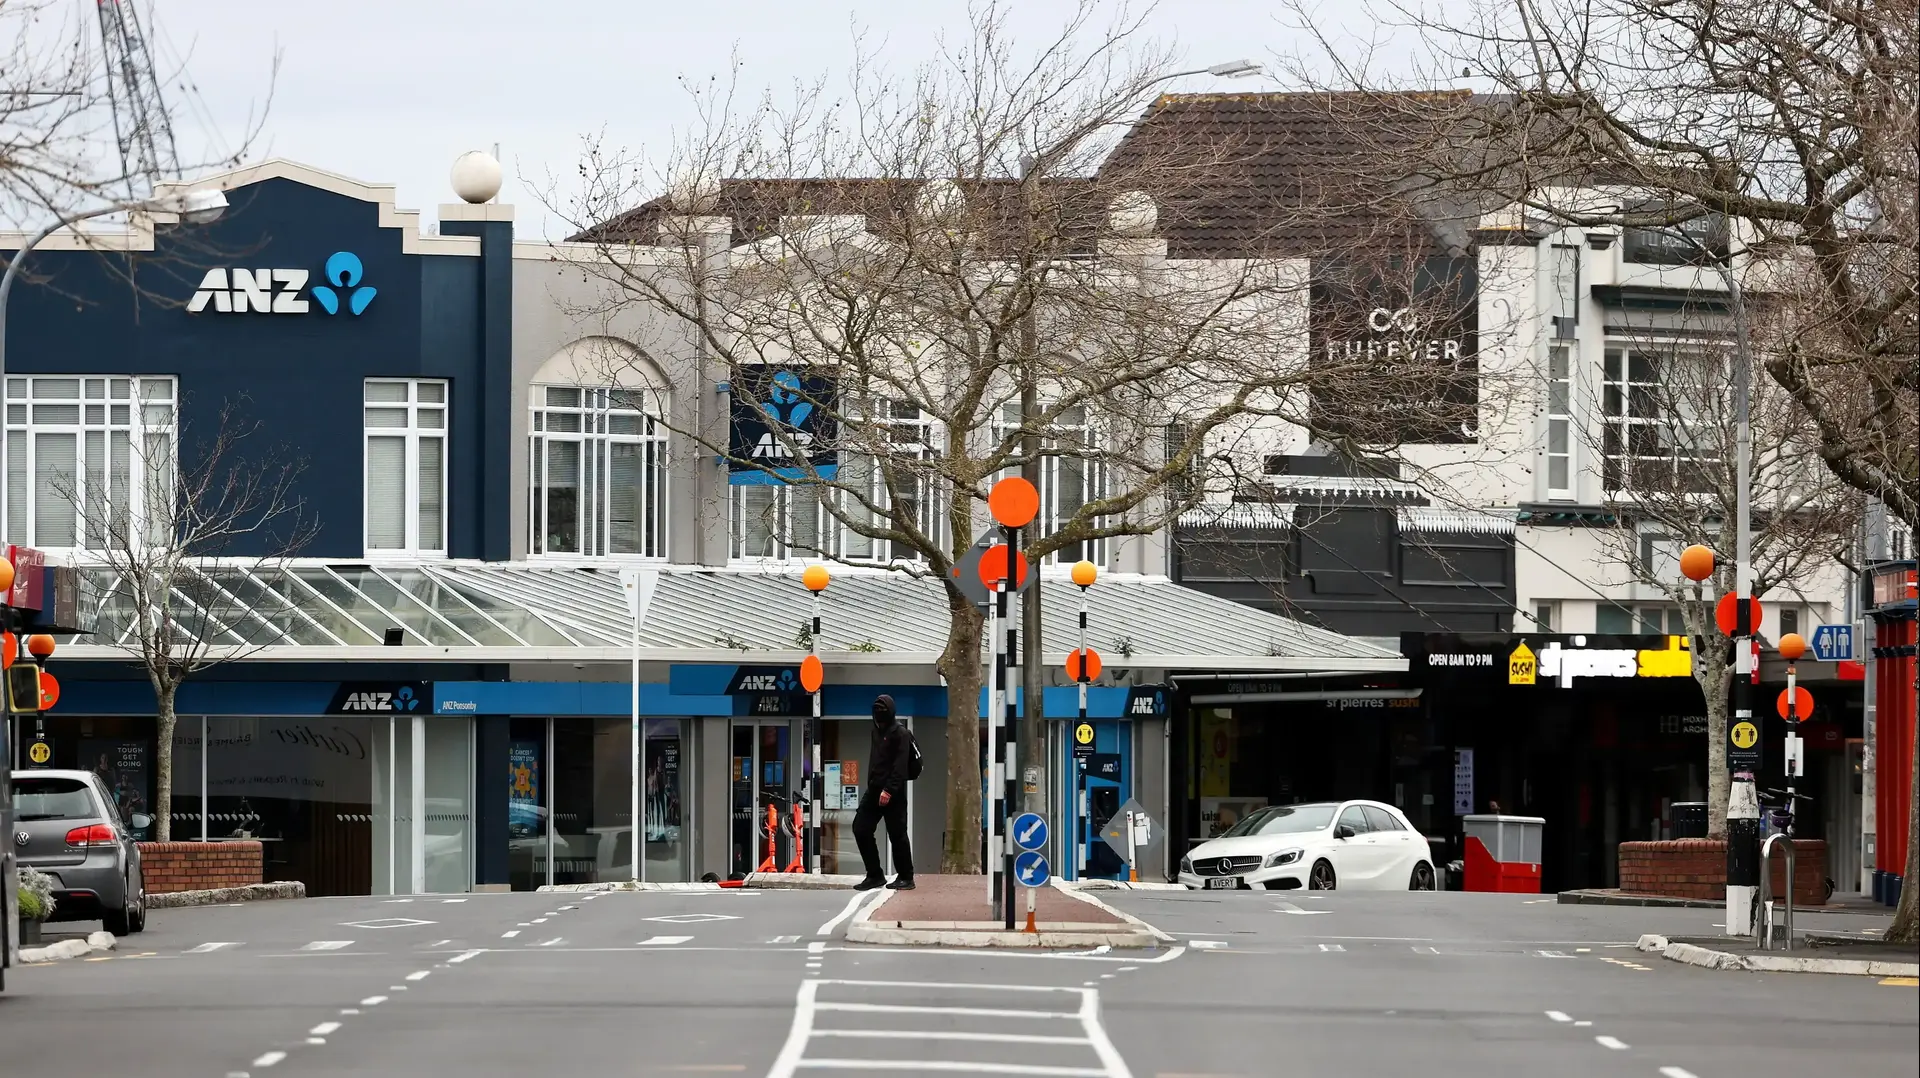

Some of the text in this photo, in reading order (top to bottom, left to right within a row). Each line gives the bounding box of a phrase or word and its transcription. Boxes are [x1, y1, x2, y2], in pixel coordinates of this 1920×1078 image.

[187, 268, 309, 313] ANZ
[752, 433, 814, 458] ANZ
[1429, 653, 1493, 666] OPEN 8AM TO 9 PM
[1512, 662, 1533, 676] SUSHI
[739, 676, 776, 690] ANZ
[342, 693, 392, 710] ANZ
[443, 701, 477, 713] ANZ Ponsonby
[1132, 697, 1153, 714] ANZ
[1341, 699, 1384, 711] pierres
[1388, 698, 1420, 708] sushi
[1102, 764, 1114, 772] ANZ
[1214, 879, 1233, 887] AVERY
